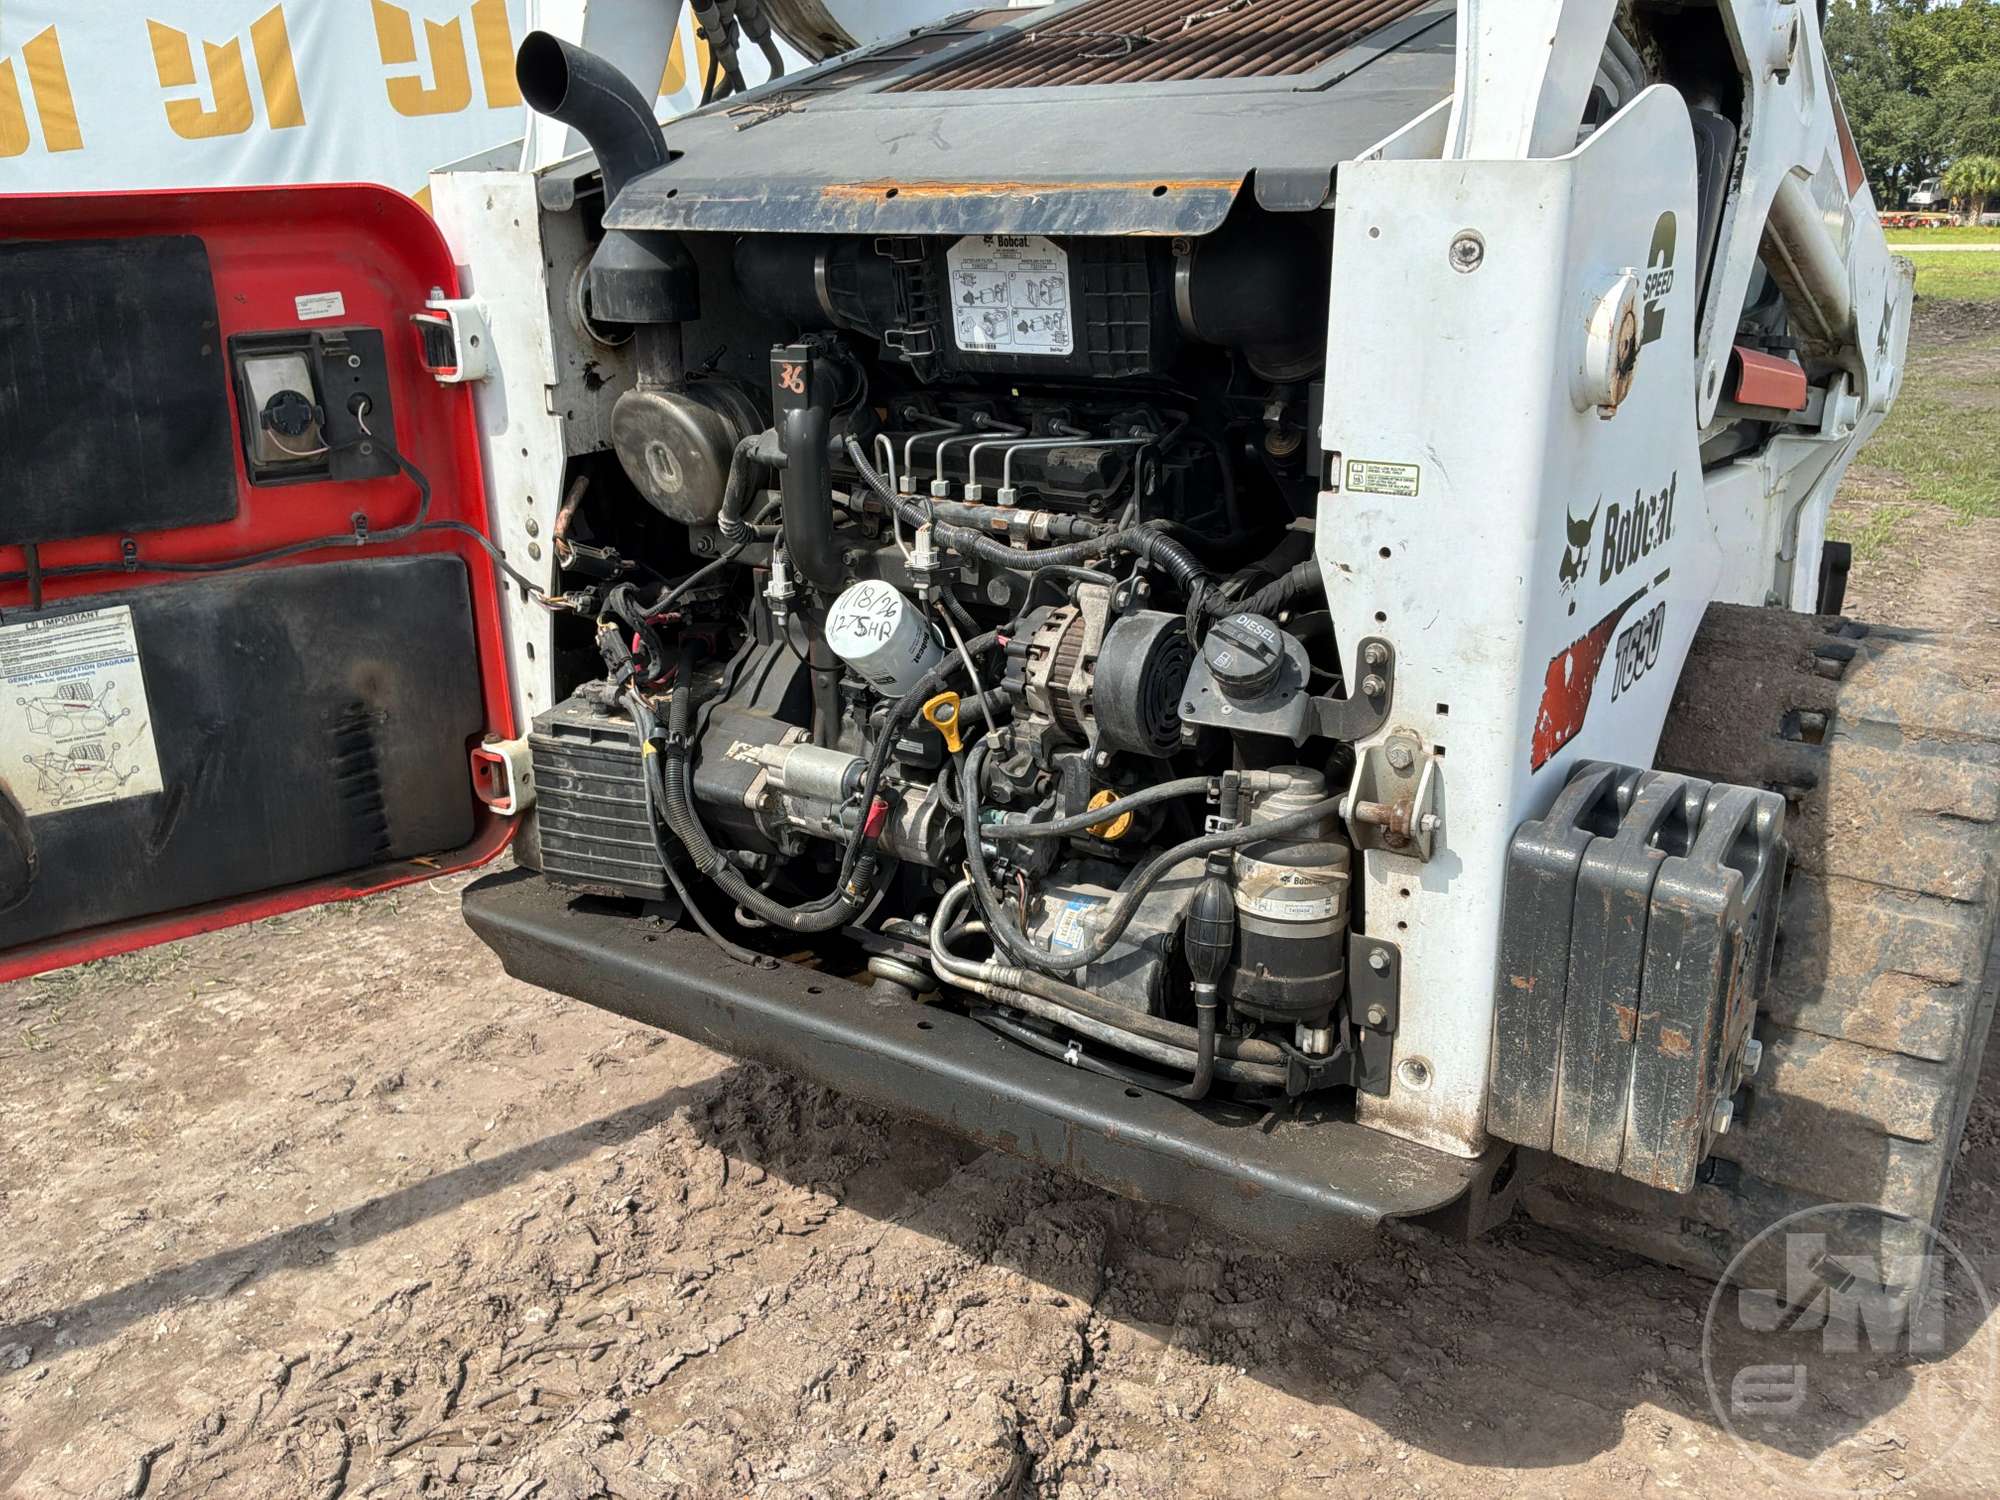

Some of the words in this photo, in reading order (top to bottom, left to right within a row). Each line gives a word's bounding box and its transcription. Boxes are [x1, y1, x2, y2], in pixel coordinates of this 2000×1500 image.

[998, 235, 1029, 248] Bobcat
[1643, 269, 1675, 302] SPEED
[777, 363, 805, 394] 36
[1599, 469, 1677, 586] Bobcat
[43, 611, 99, 626] IMPORTANT
[1236, 615, 1277, 643] DIESEL
[1611, 601, 1666, 703] T650
[8, 673, 43, 684] GENERAL
[45, 663, 96, 678] LUBRICATION
[97, 657, 135, 668] DIAGRAMS
